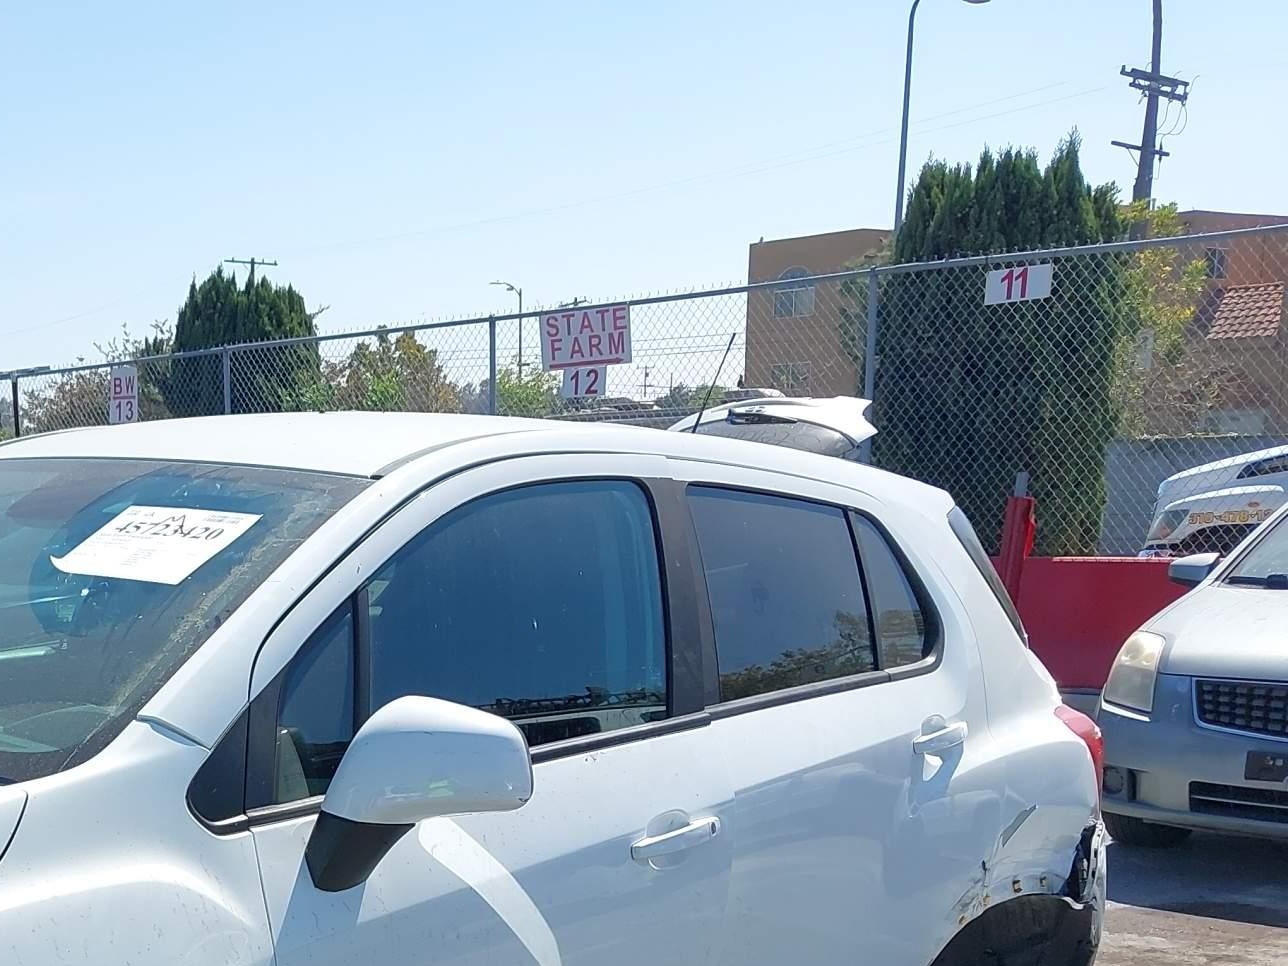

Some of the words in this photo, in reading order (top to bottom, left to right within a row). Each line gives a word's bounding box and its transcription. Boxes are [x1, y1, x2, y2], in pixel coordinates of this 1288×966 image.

[1001, 268, 1028, 300] 11
[546, 307, 627, 337] STATE
[550, 331, 625, 360] FARM
[570, 368, 599, 395] 12
[115, 400, 134, 421] 13
[115, 521, 225, 541] 45723420
